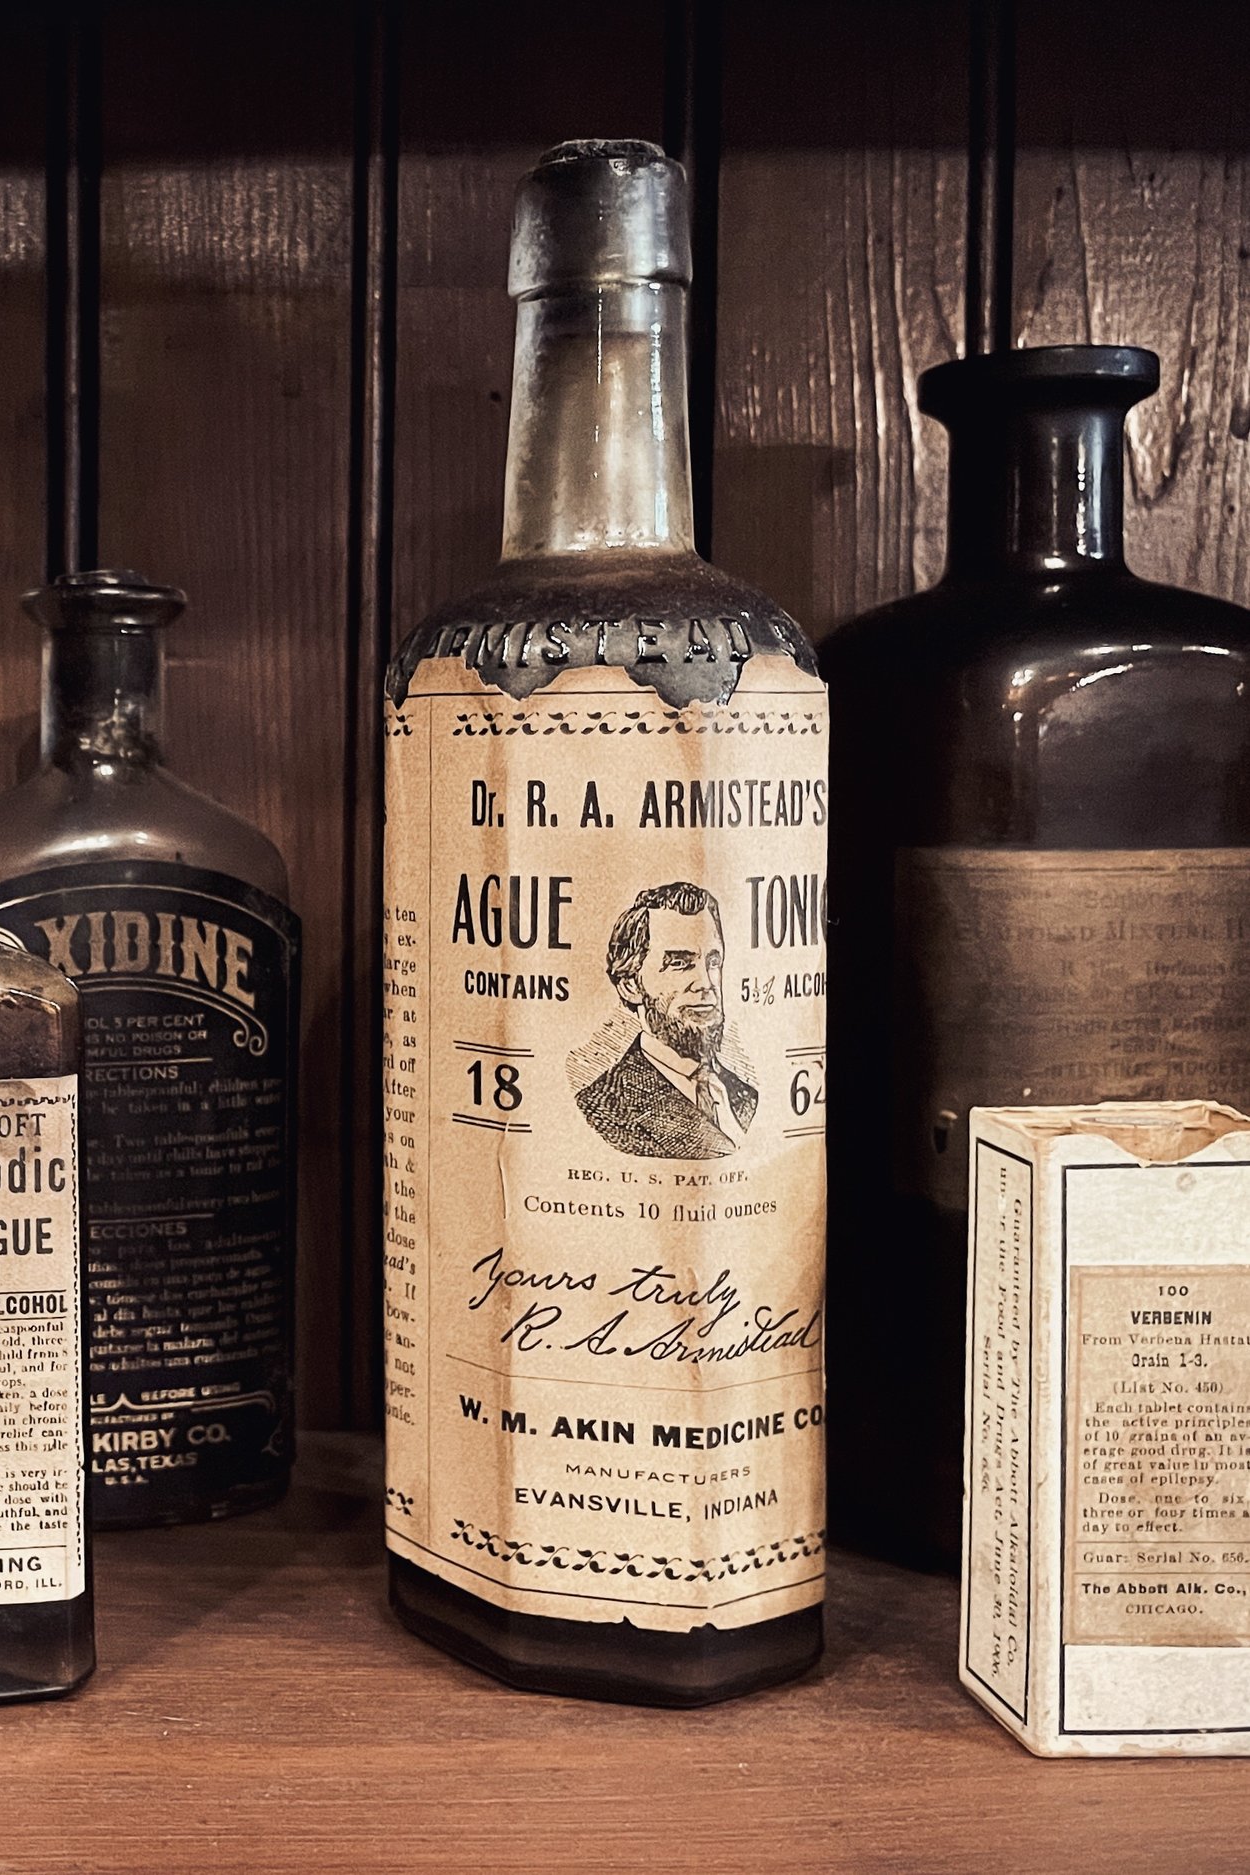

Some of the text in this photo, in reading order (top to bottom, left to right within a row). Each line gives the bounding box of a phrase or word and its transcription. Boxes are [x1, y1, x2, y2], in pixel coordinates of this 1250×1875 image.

[472, 780, 827, 829] Dr. R. A. ARMISTEAD'S
[395, 908, 417, 922] ten
[452, 873, 573, 950] AGUE
[34, 911, 255, 1011] XIDINE
[464, 970, 570, 1002] CONTAINS
[127, 1014, 205, 1028] PER CENT
[466, 1059, 523, 1111] 18
[385, 1105, 415, 1124] your
[568, 1168, 749, 1187] REG. U. S. PAT. OFF.
[394, 1181, 415, 1198] the
[524, 1195, 778, 1222] Contents 10 fluid ounces
[387, 1228, 415, 1250] dose
[468, 1247, 740, 1337] Yours truly
[1158, 1285, 1189, 1297] 100
[1131, 1310, 1212, 1325] VERBENIN
[1082, 1333, 1250, 1345] From Verbena Hastat
[1132, 1353, 1169, 1368] Grain
[1161, 1382, 1189, 1394] No.
[1094, 1402, 1132, 1413] Each
[1138, 1402, 1182, 1413] tablet
[459, 1394, 489, 1424] W.
[501, 1411, 537, 1435] M.
[551, 1416, 635, 1445] AKIN
[652, 1411, 785, 1450] MEDICINE
[92, 1423, 232, 1452] KIRBY CO.
[565, 1463, 751, 1486] MANUFACTURERS
[1104, 1459, 1189, 1472] great value
[514, 1487, 778, 1523] EVANSVILLE, INDIANA
[1137, 1551, 1215, 1563] Serial No.
[1082, 1583, 1247, 1596] The Abbott Alk. Co.,
[1125, 1604, 1203, 1614] CHICAGO.
